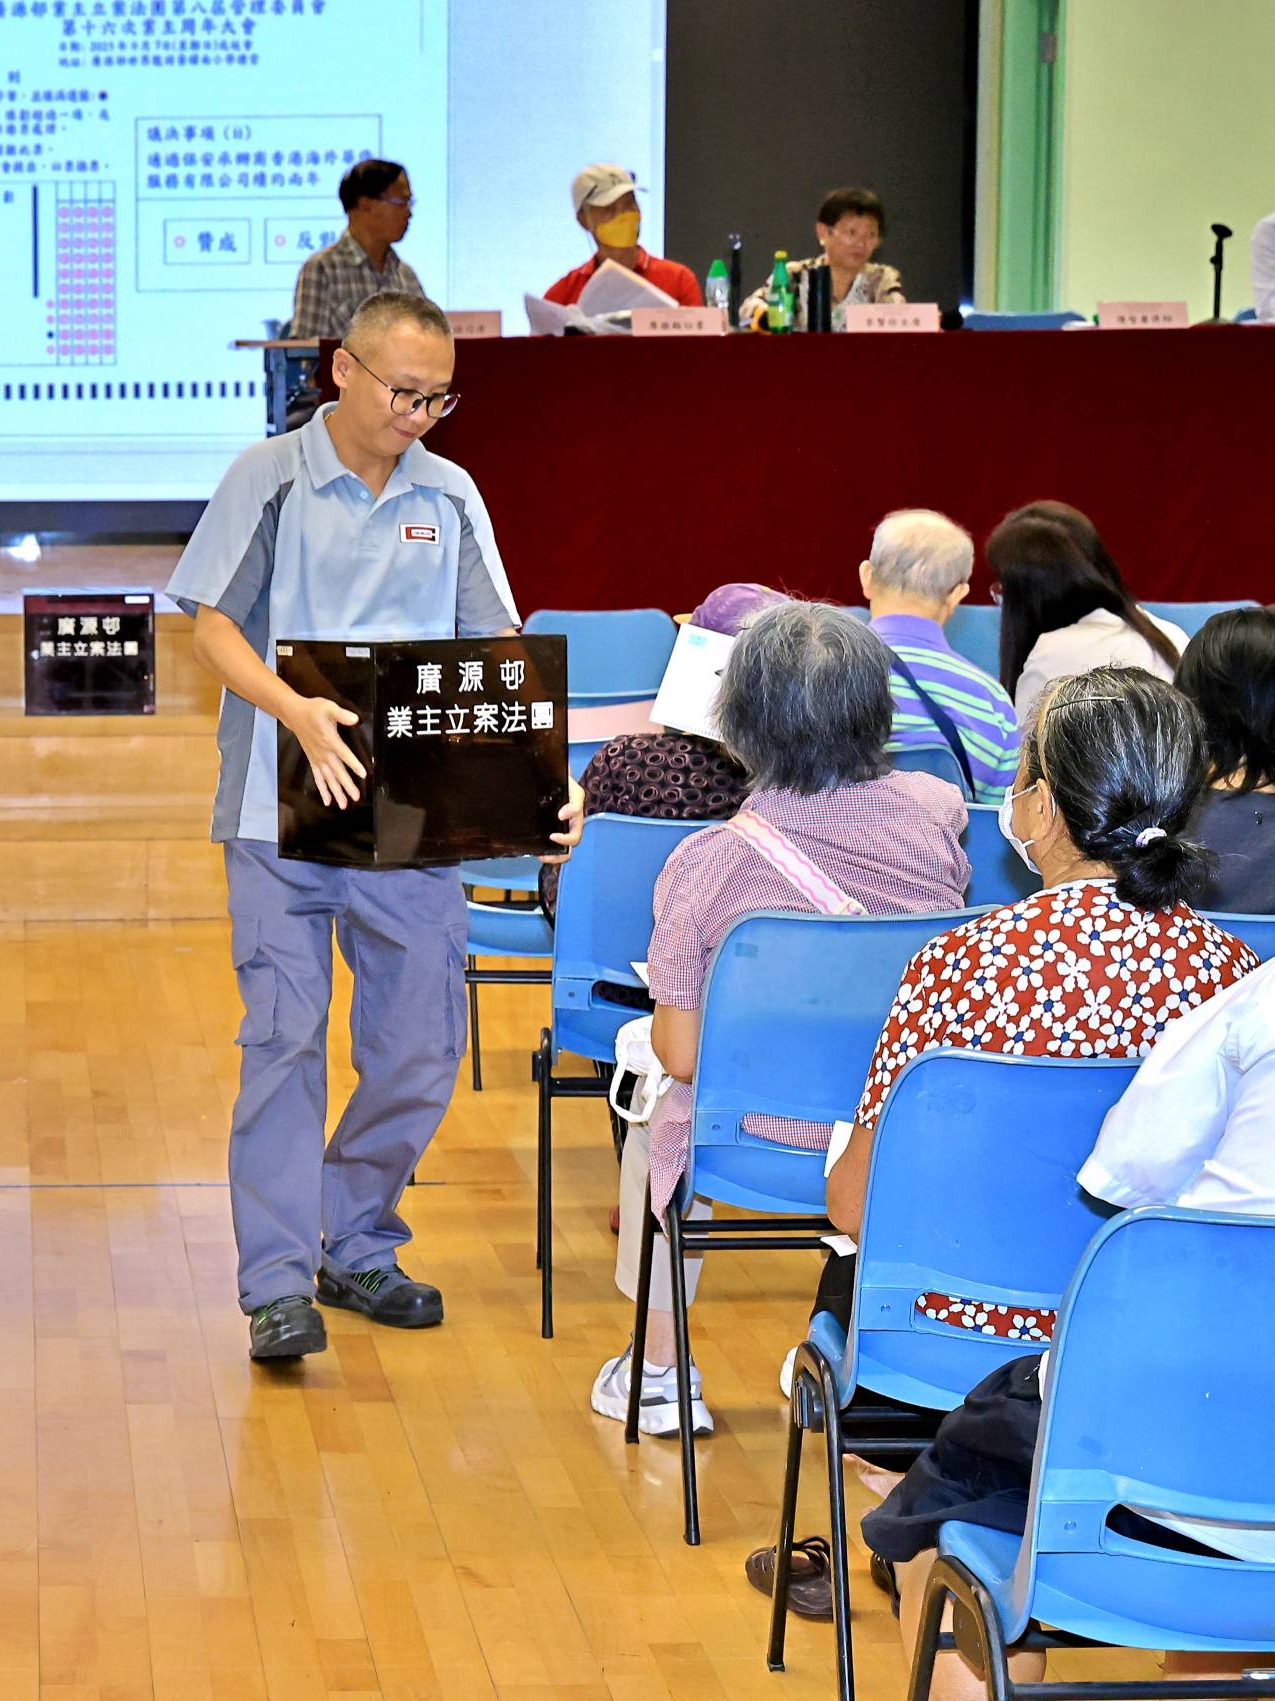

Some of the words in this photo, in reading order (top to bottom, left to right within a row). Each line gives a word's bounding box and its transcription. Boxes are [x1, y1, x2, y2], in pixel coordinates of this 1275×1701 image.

[197, 230, 237, 253] 贊成
[57, 616, 121, 636] 廣源邨
[40, 640, 139, 657] 業主立案法團
[416, 658, 526, 695] 廣源邨
[386, 700, 555, 739] 業主立案法團
